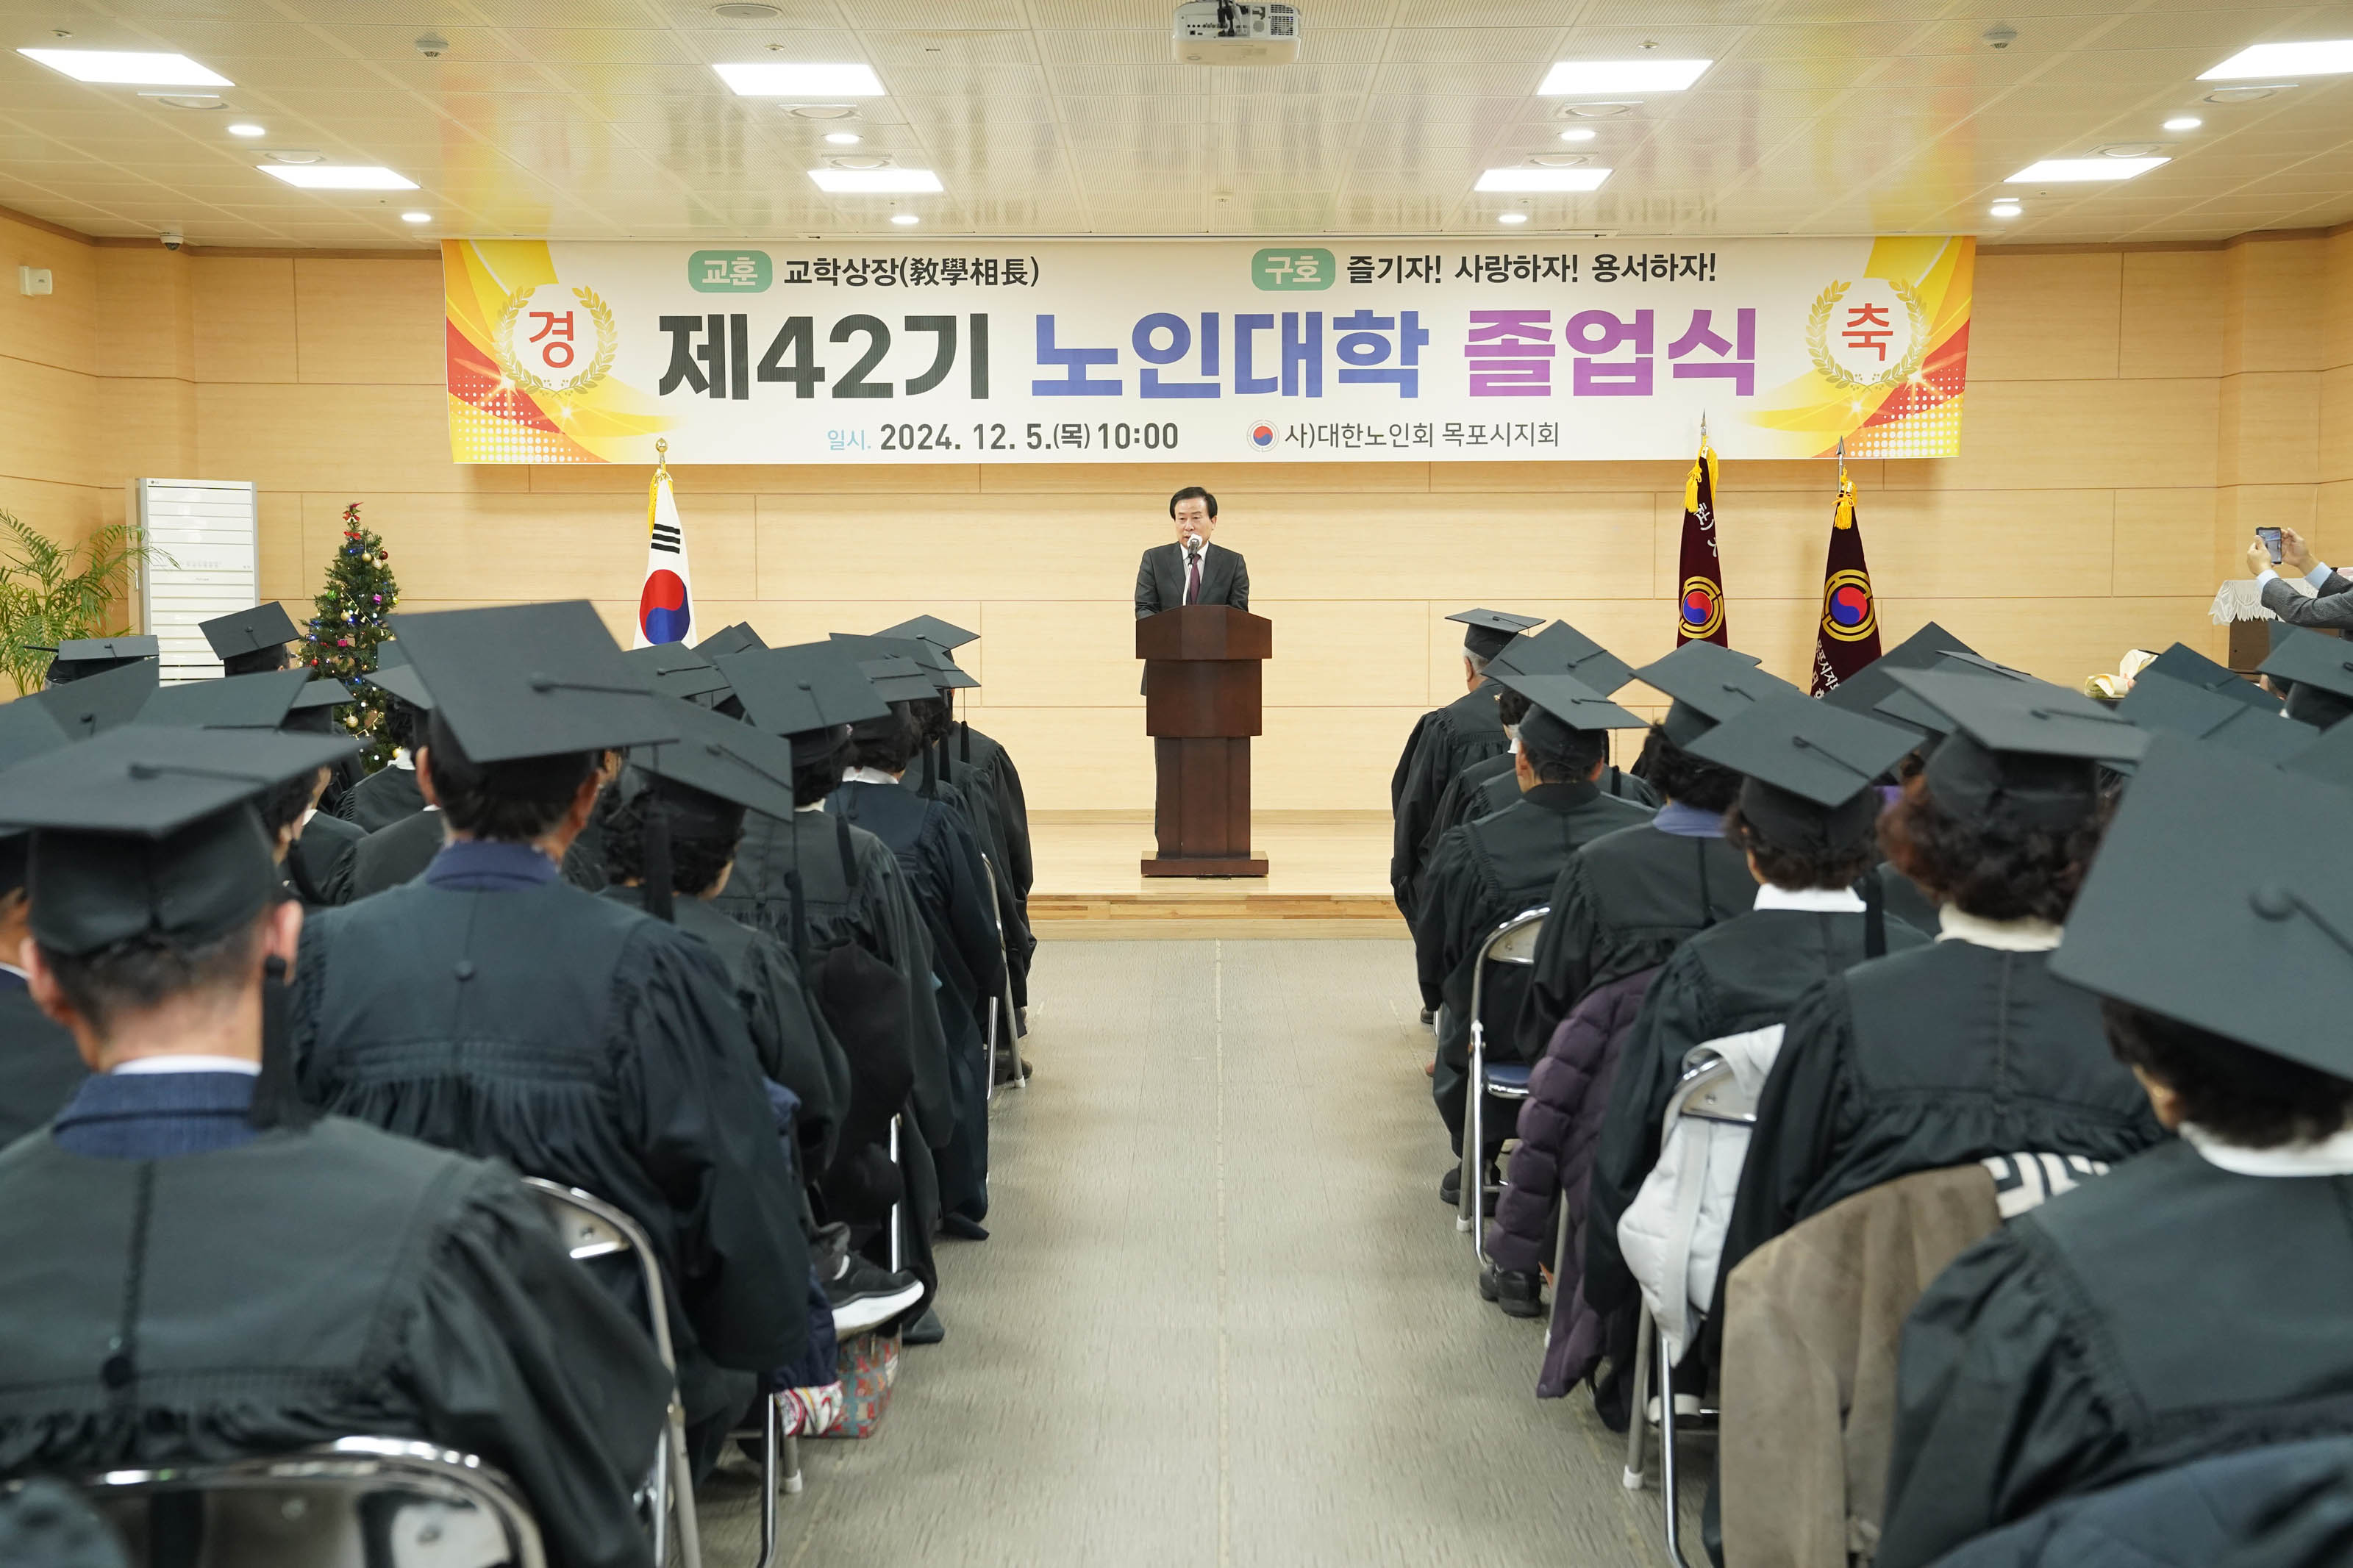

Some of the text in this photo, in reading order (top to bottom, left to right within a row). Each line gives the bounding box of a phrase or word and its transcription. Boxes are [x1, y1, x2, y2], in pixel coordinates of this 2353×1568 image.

[702, 257, 758, 286] 교훈
[1265, 256, 1321, 284] 구호
[1346, 252, 1716, 284] 즐기자! 사랑하자! 용서하자!
[529, 310, 575, 368] 경
[1841, 302, 1894, 362] 축
[659, 307, 1757, 401] 제42기 노인대학 졸업식
[827, 422, 1178, 451] 일시. 2024. 12. 5.(목) 10:00
[1285, 421, 1559, 448] 사)대한노인회 목포시지회
